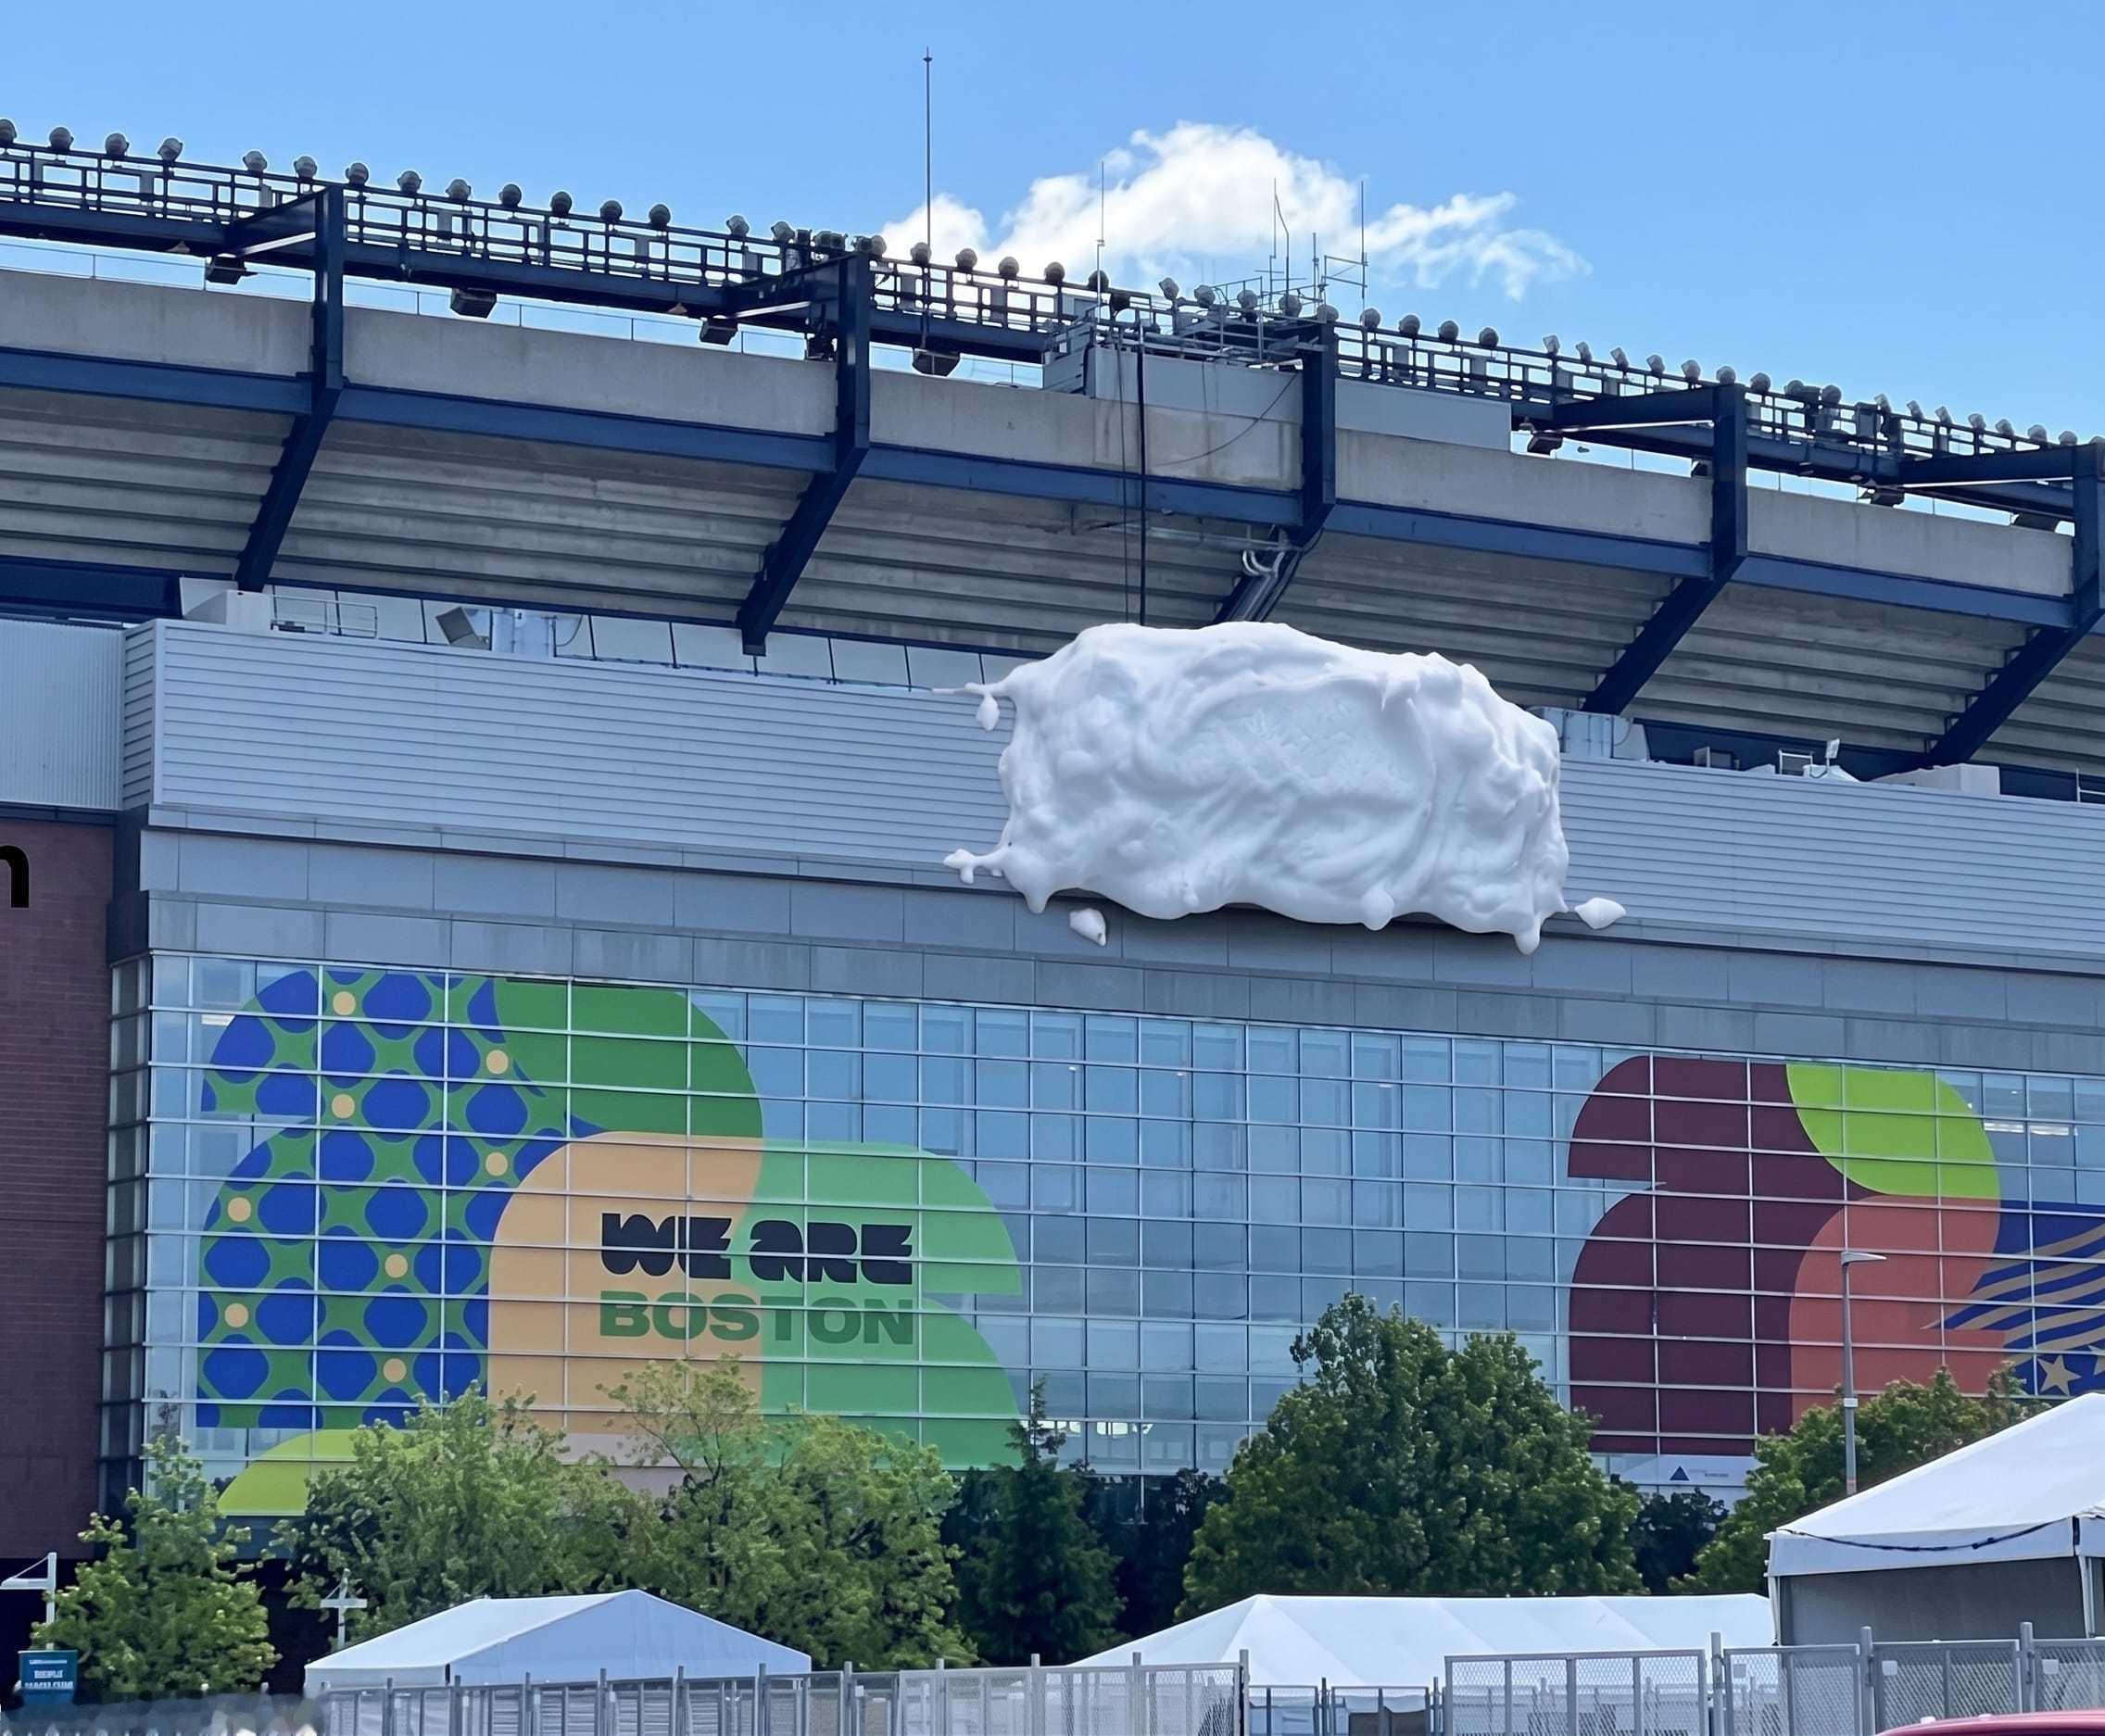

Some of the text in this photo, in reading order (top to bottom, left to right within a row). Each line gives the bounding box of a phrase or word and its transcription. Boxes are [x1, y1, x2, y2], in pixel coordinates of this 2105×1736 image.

[601, 1213, 913, 1285] WE ARE
[599, 1290, 914, 1345] BOSTON
